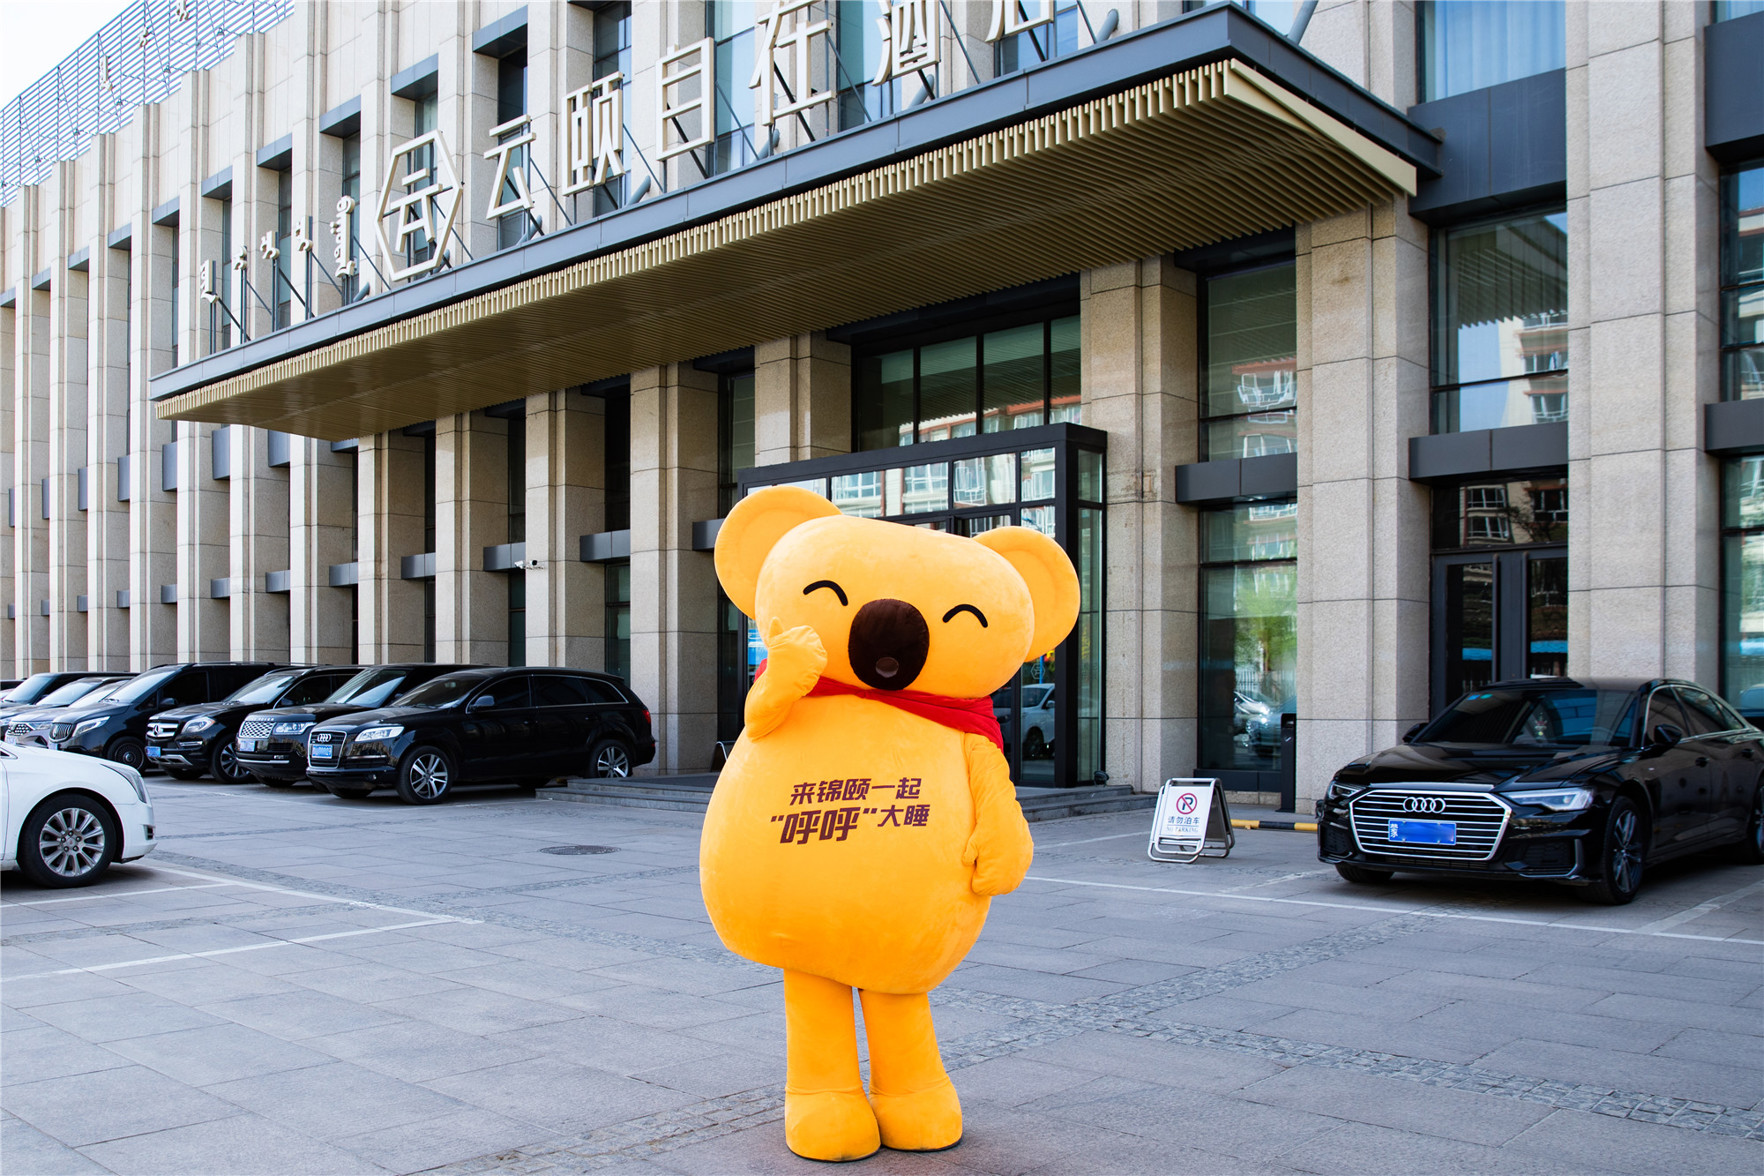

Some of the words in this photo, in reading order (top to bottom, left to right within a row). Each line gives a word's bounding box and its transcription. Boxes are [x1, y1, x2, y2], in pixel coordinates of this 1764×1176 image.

[789, 777, 922, 806] 来锦颐一起
[1168, 816, 1200, 824] 请勿泊车
